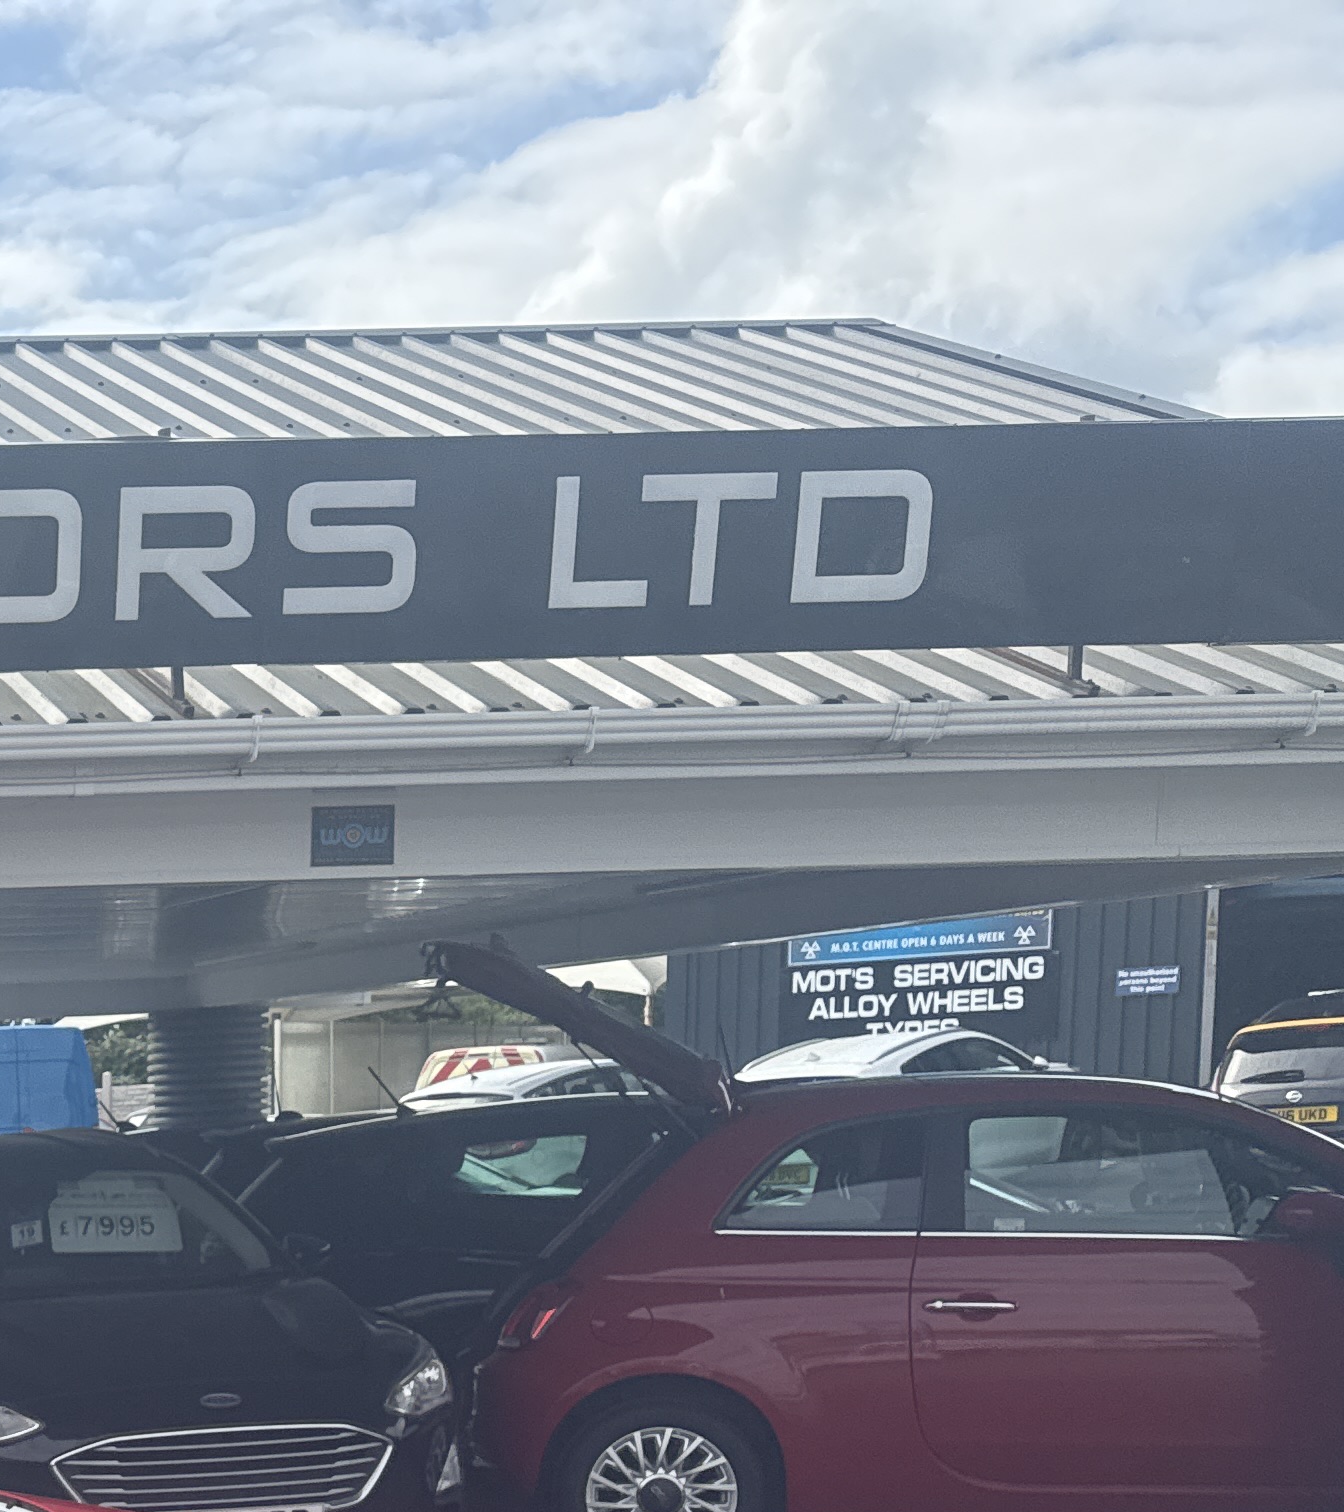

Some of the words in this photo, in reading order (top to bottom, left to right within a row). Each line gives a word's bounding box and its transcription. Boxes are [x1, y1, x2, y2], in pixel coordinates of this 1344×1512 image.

[548, 469, 934, 609] LTD
[862, 939, 899, 951] CENTRE
[901, 936, 928, 948] OPEN
[939, 934, 965, 946] DAYS
[967, 933, 975, 943] A
[977, 931, 1006, 943] WEEK
[791, 966, 874, 994] MOT'S
[894, 956, 1045, 988] SERVICING
[808, 992, 898, 1020] ALLOY
[907, 986, 1024, 1016] WHEELS
[1298, 1108, 1328, 1121] UKD
